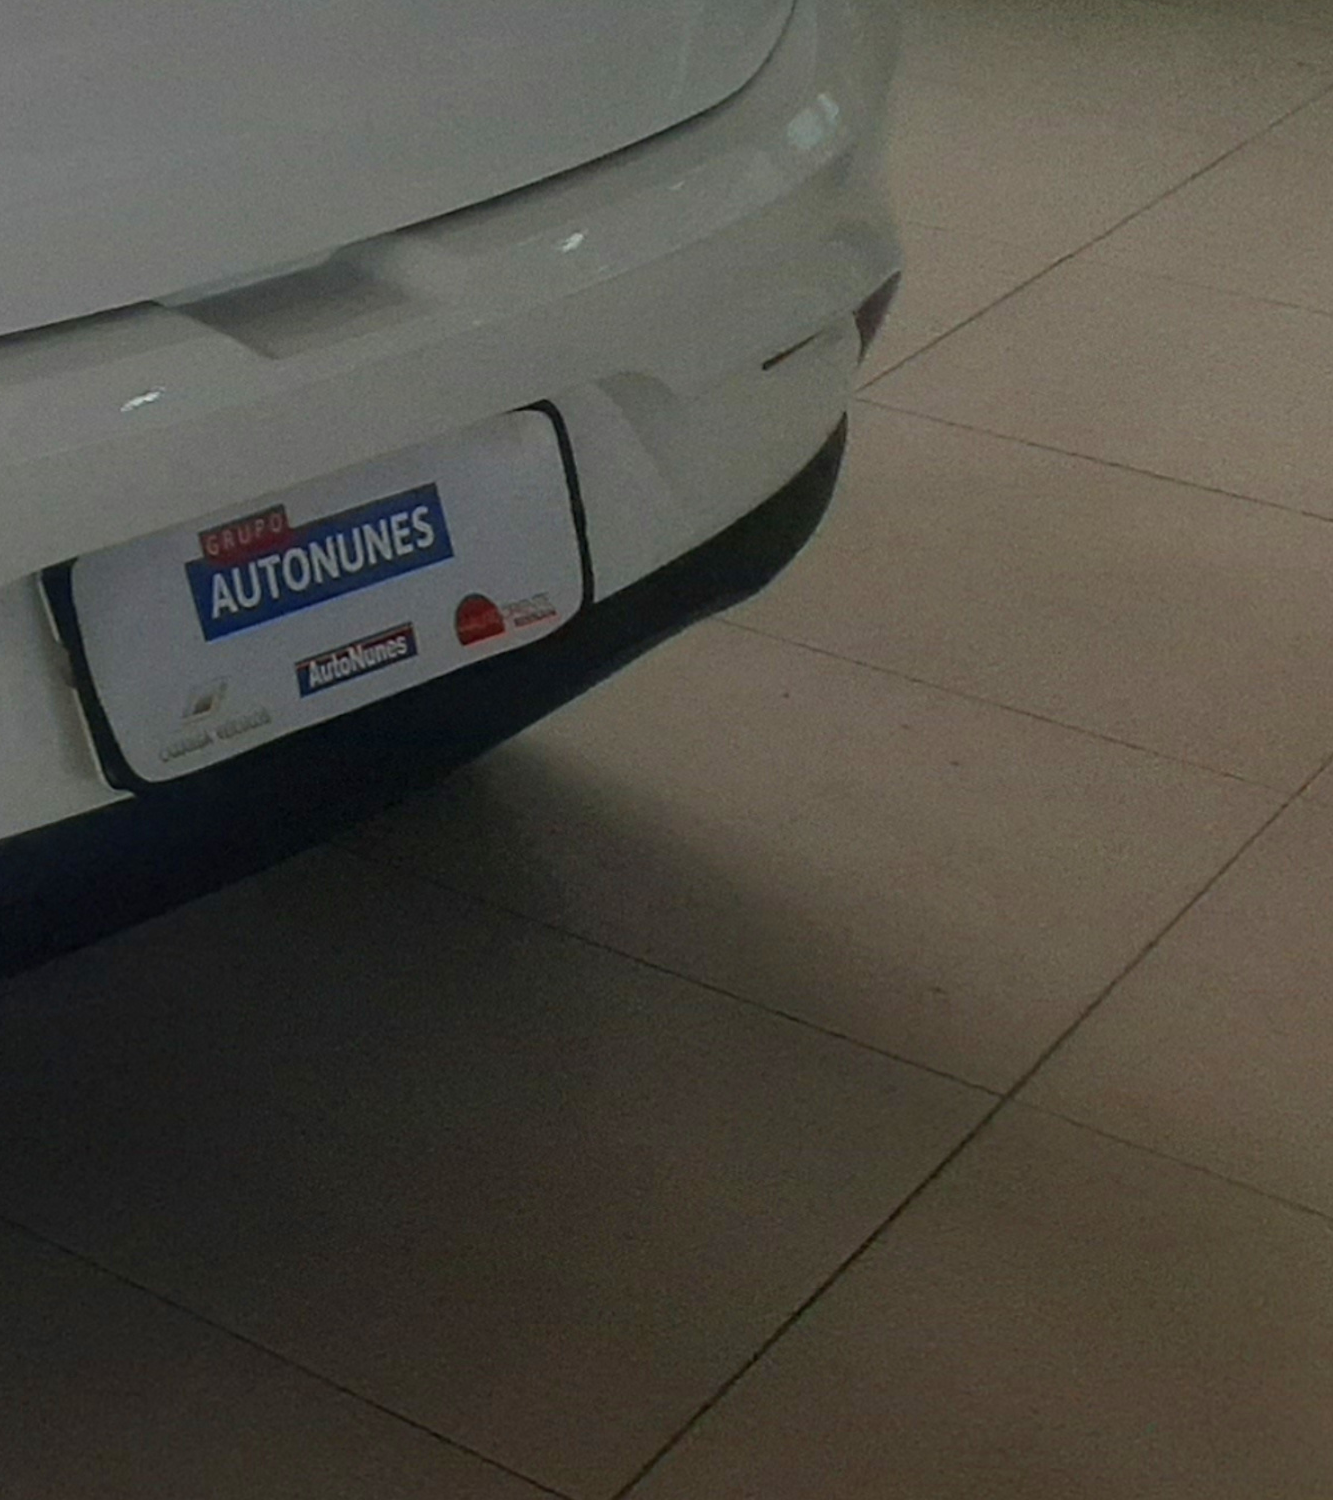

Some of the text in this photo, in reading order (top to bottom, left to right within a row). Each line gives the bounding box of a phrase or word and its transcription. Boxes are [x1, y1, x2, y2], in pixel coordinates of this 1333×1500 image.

[206, 513, 284, 557] GRUPO
[211, 506, 435, 619] AUTONUNES
[307, 635, 408, 690] AutoNunes
